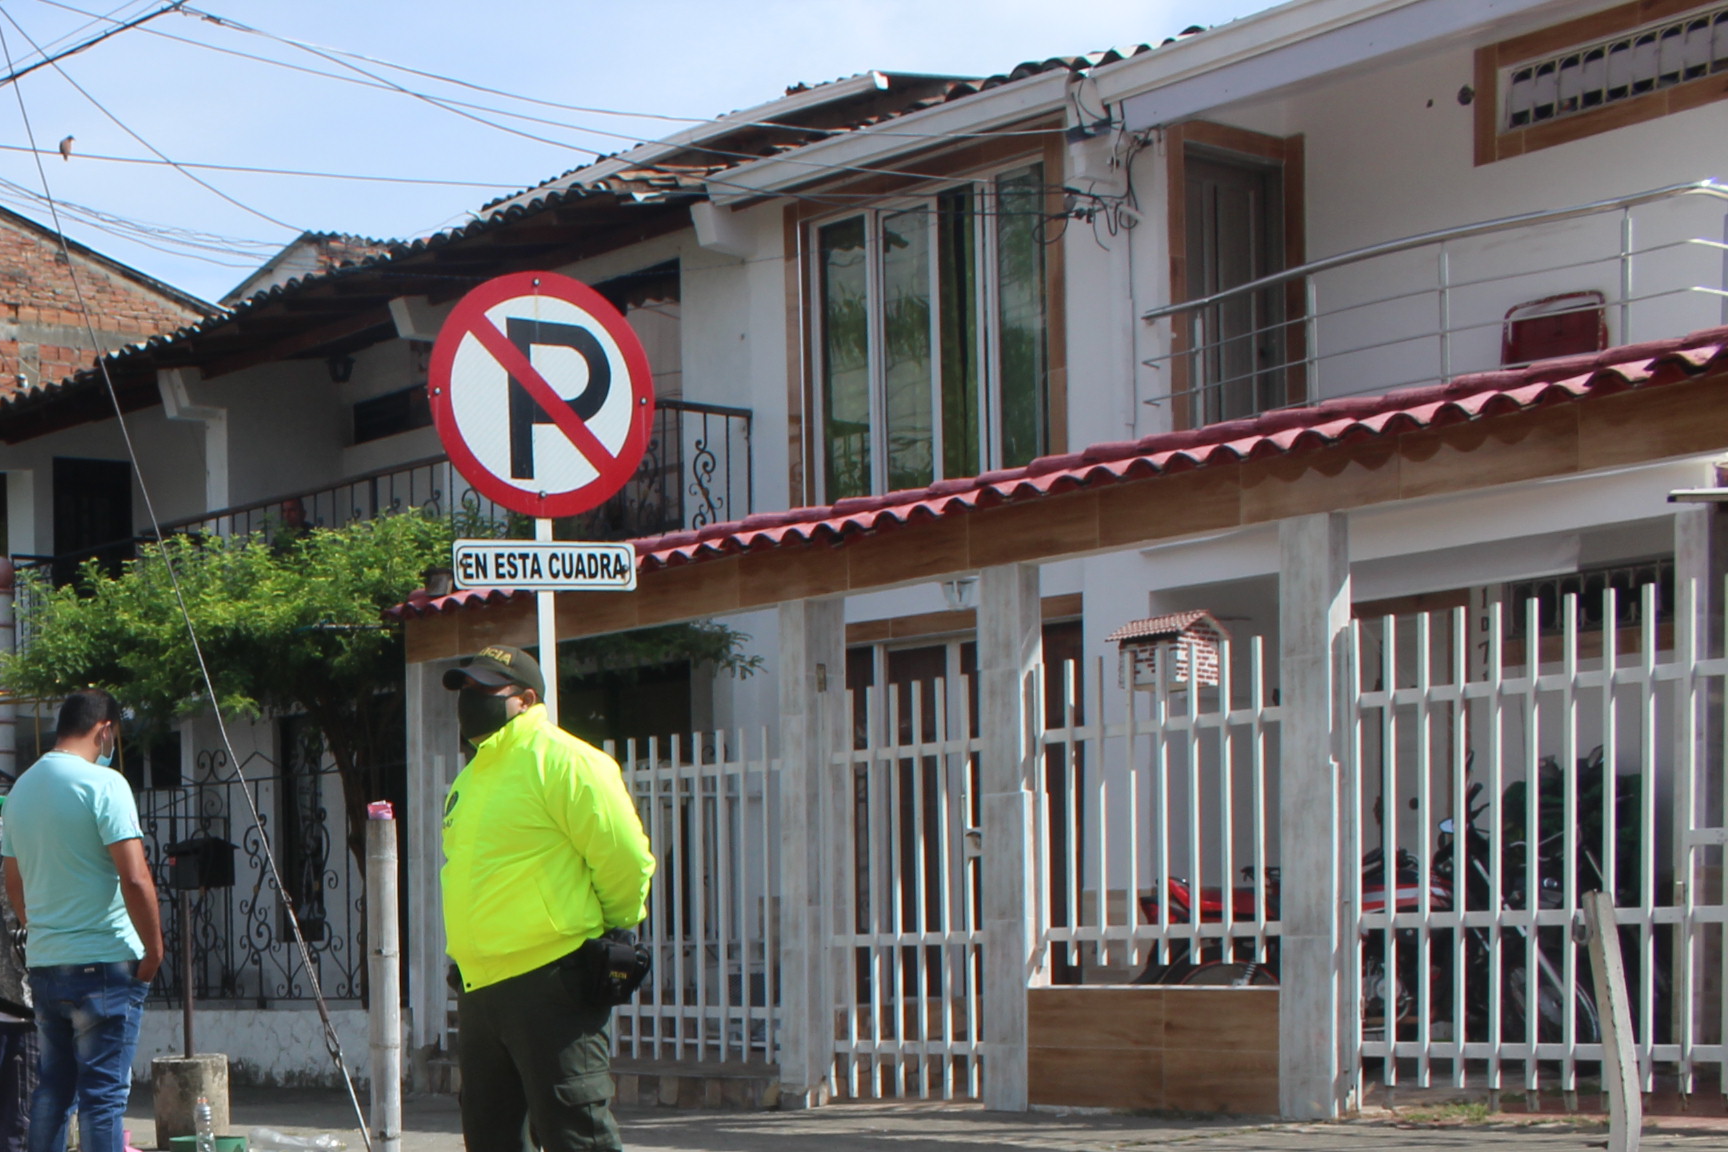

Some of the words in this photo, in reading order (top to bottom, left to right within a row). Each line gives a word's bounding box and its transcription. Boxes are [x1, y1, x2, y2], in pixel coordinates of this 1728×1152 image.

[506, 316, 612, 480] P
[461, 553, 488, 580] EN
[494, 553, 542, 580] ESTA
[548, 553, 625, 580] CUADRA
